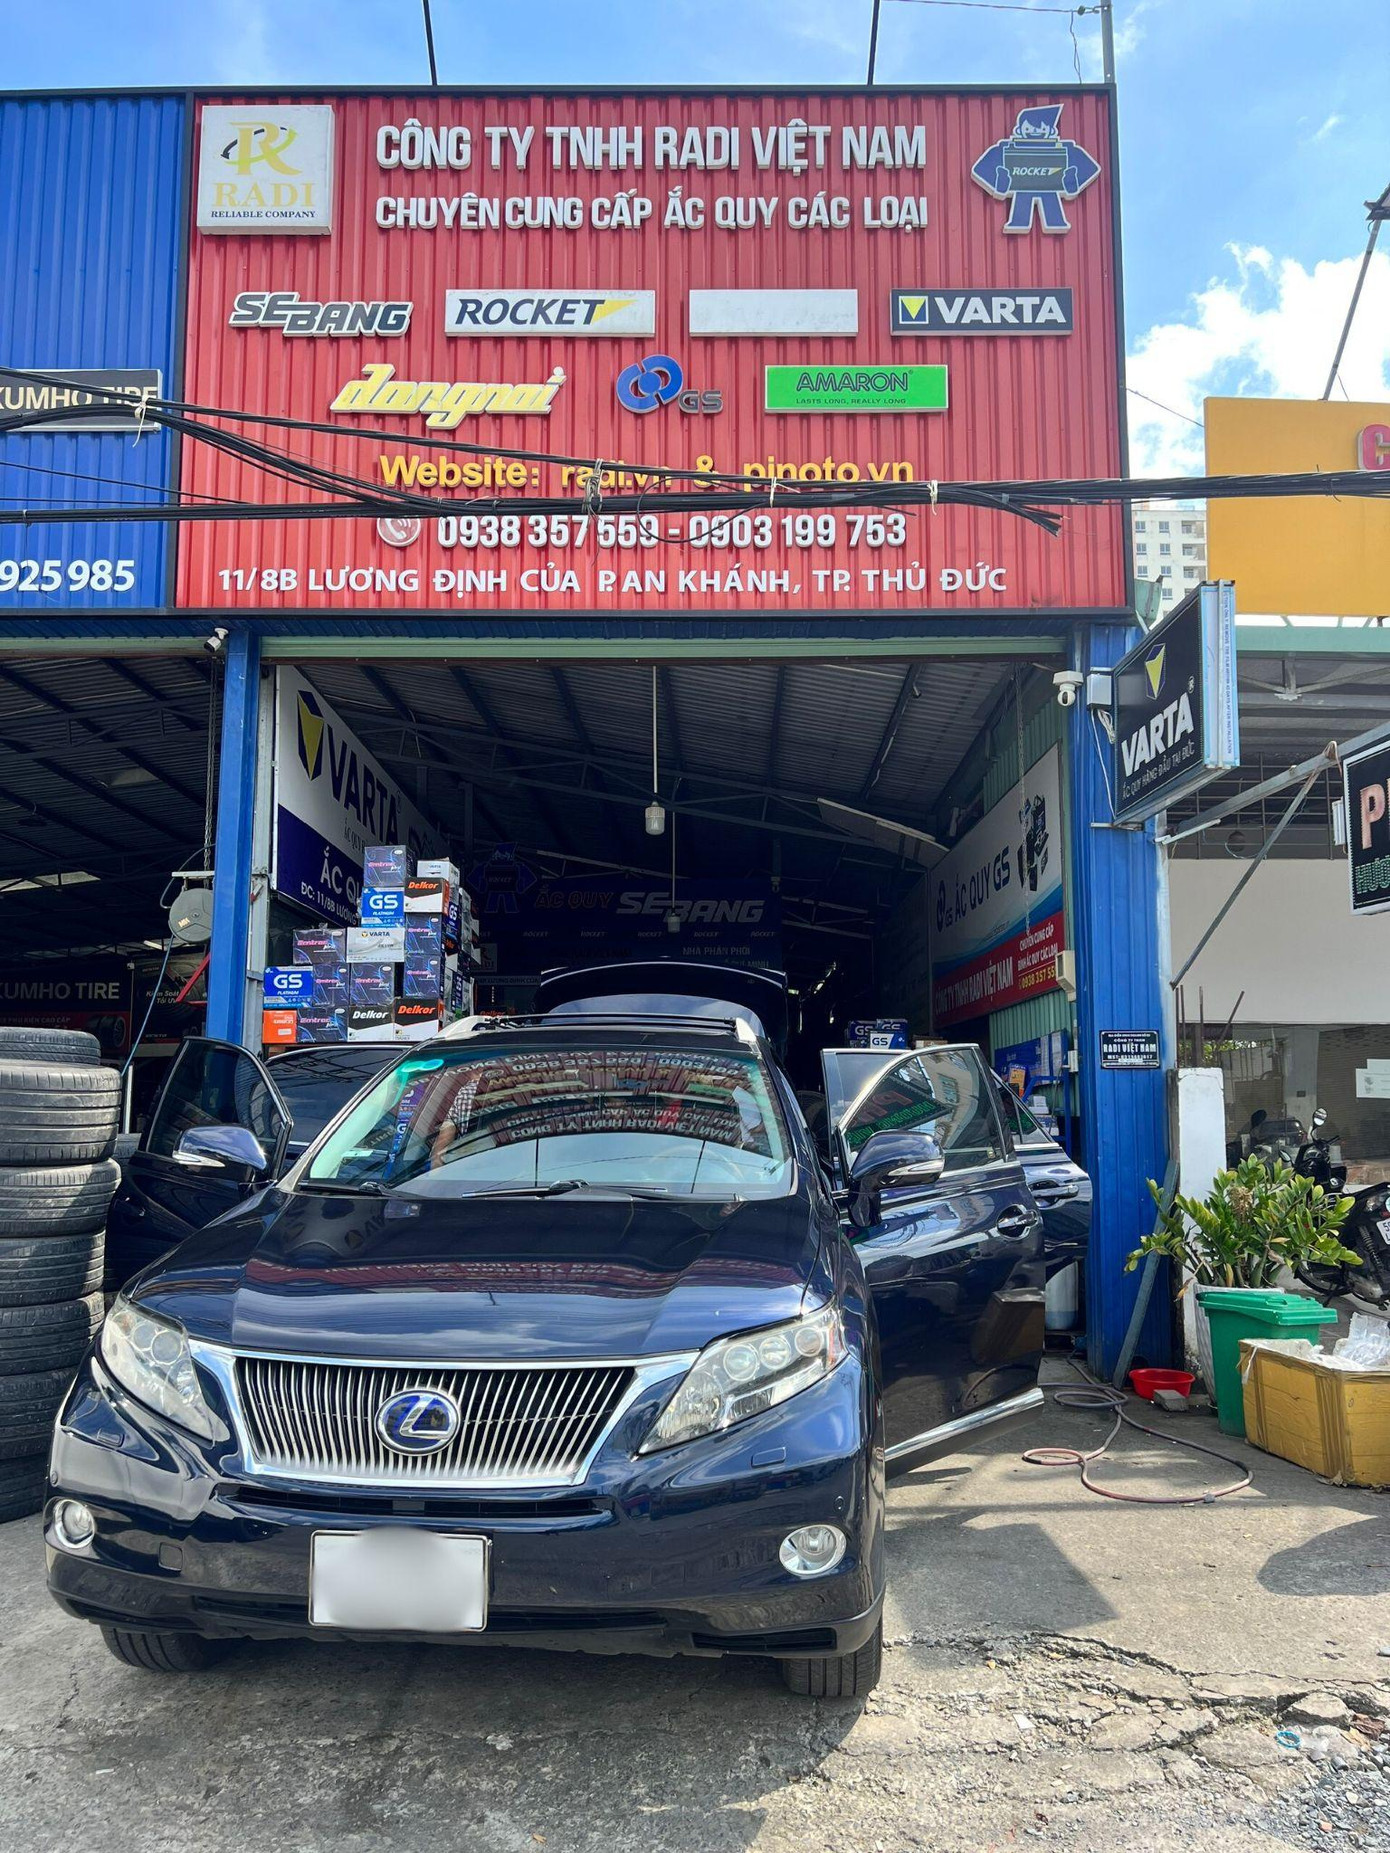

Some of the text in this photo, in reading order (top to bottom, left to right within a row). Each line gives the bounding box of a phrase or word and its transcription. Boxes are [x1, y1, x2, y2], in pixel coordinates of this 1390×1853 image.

[376, 118, 926, 176] CÔNG TY TNHH RADI VIỆT NAM
[1012, 167, 1056, 176] ROCKET
[212, 182, 314, 207] RADI
[211, 210, 316, 219] RELIABLE COMPANY
[375, 185, 927, 233] CHUYÊN CUNG CẤP ẮC QUY CÁC LOẠI
[229, 291, 413, 337] SEBANG
[456, 298, 607, 326] ROCKET
[934, 297, 1066, 325] VARTA
[797, 372, 908, 392] AMARON
[0, 386, 92, 410] UMHO
[677, 389, 723, 414] GS
[380, 455, 539, 489] Website:
[438, 515, 520, 548] 0938
[528, 515, 588, 548] 357
[597, 515, 659, 548] 559
[689, 515, 772, 548] 0903
[782, 515, 836, 548] 199
[846, 513, 906, 548] 753
[68, 560, 135, 592] 985
[218, 568, 298, 592] 11/8B
[309, 565, 419, 592] LƯƠNG
[433, 568, 507, 598] ĐỊNH
[520, 561, 581, 592] CỦA
[678, 562, 801, 595] KHÁNH,
[862, 561, 926, 591] THỦ
[940, 562, 1007, 591] ĐỨC
[1121, 693, 1194, 777] VARTA
[327, 722, 398, 845] VARTA
[321, 845, 343, 894] ẮC
[969, 862, 991, 914] QUY
[993, 845, 1010, 892] GS
[408, 881, 438, 889] Delkor
[369, 894, 399, 910] GS
[617, 891, 765, 923] SEBANG
[273, 974, 303, 989] GS
[997, 956, 1014, 991] NAM
[75, 982, 120, 999] TIRE
[353, 1010, 389, 1019] Delkor
[398, 1005, 436, 1014] Delkor
[855, 1025, 874, 1036] GS
[872, 1037, 888, 1046] GS
[1103, 1043, 1121, 1052] RADI
[1140, 1043, 1156, 1052] NAM
